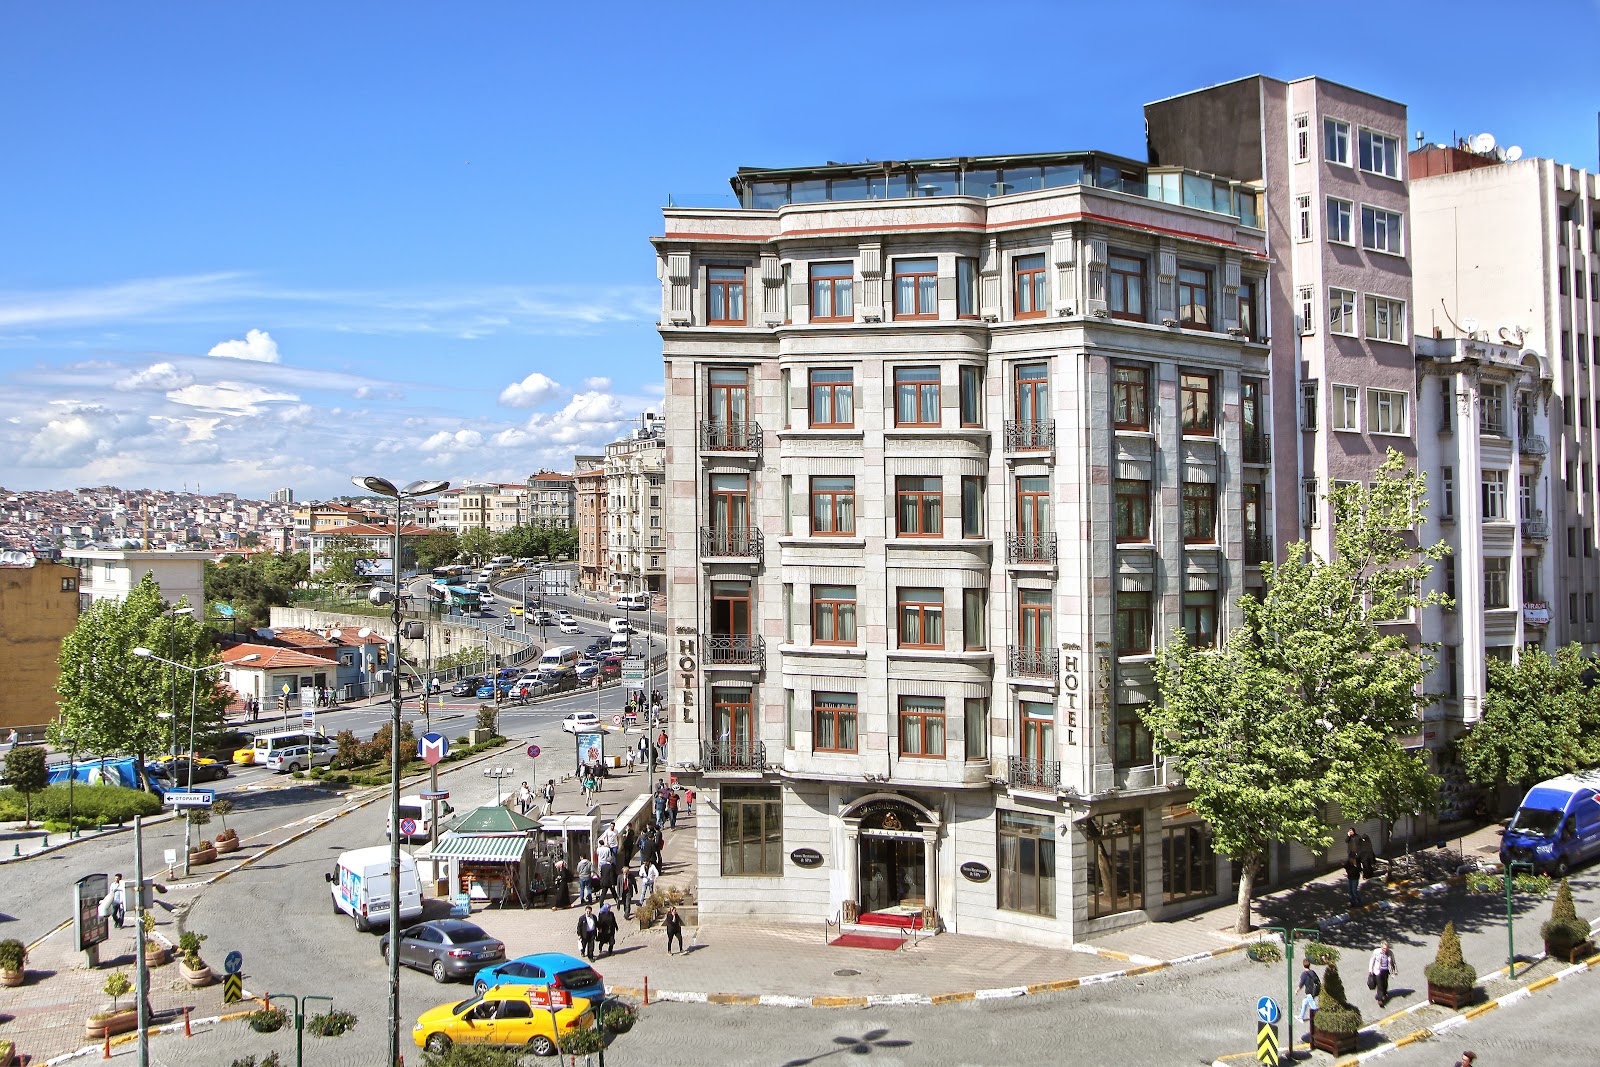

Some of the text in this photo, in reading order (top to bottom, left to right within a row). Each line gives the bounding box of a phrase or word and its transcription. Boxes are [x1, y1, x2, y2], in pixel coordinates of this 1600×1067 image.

[679, 640, 696, 723] HOTEL
[1065, 656, 1079, 746] HOTEL
[1098, 656, 1111, 746] HOTEL
